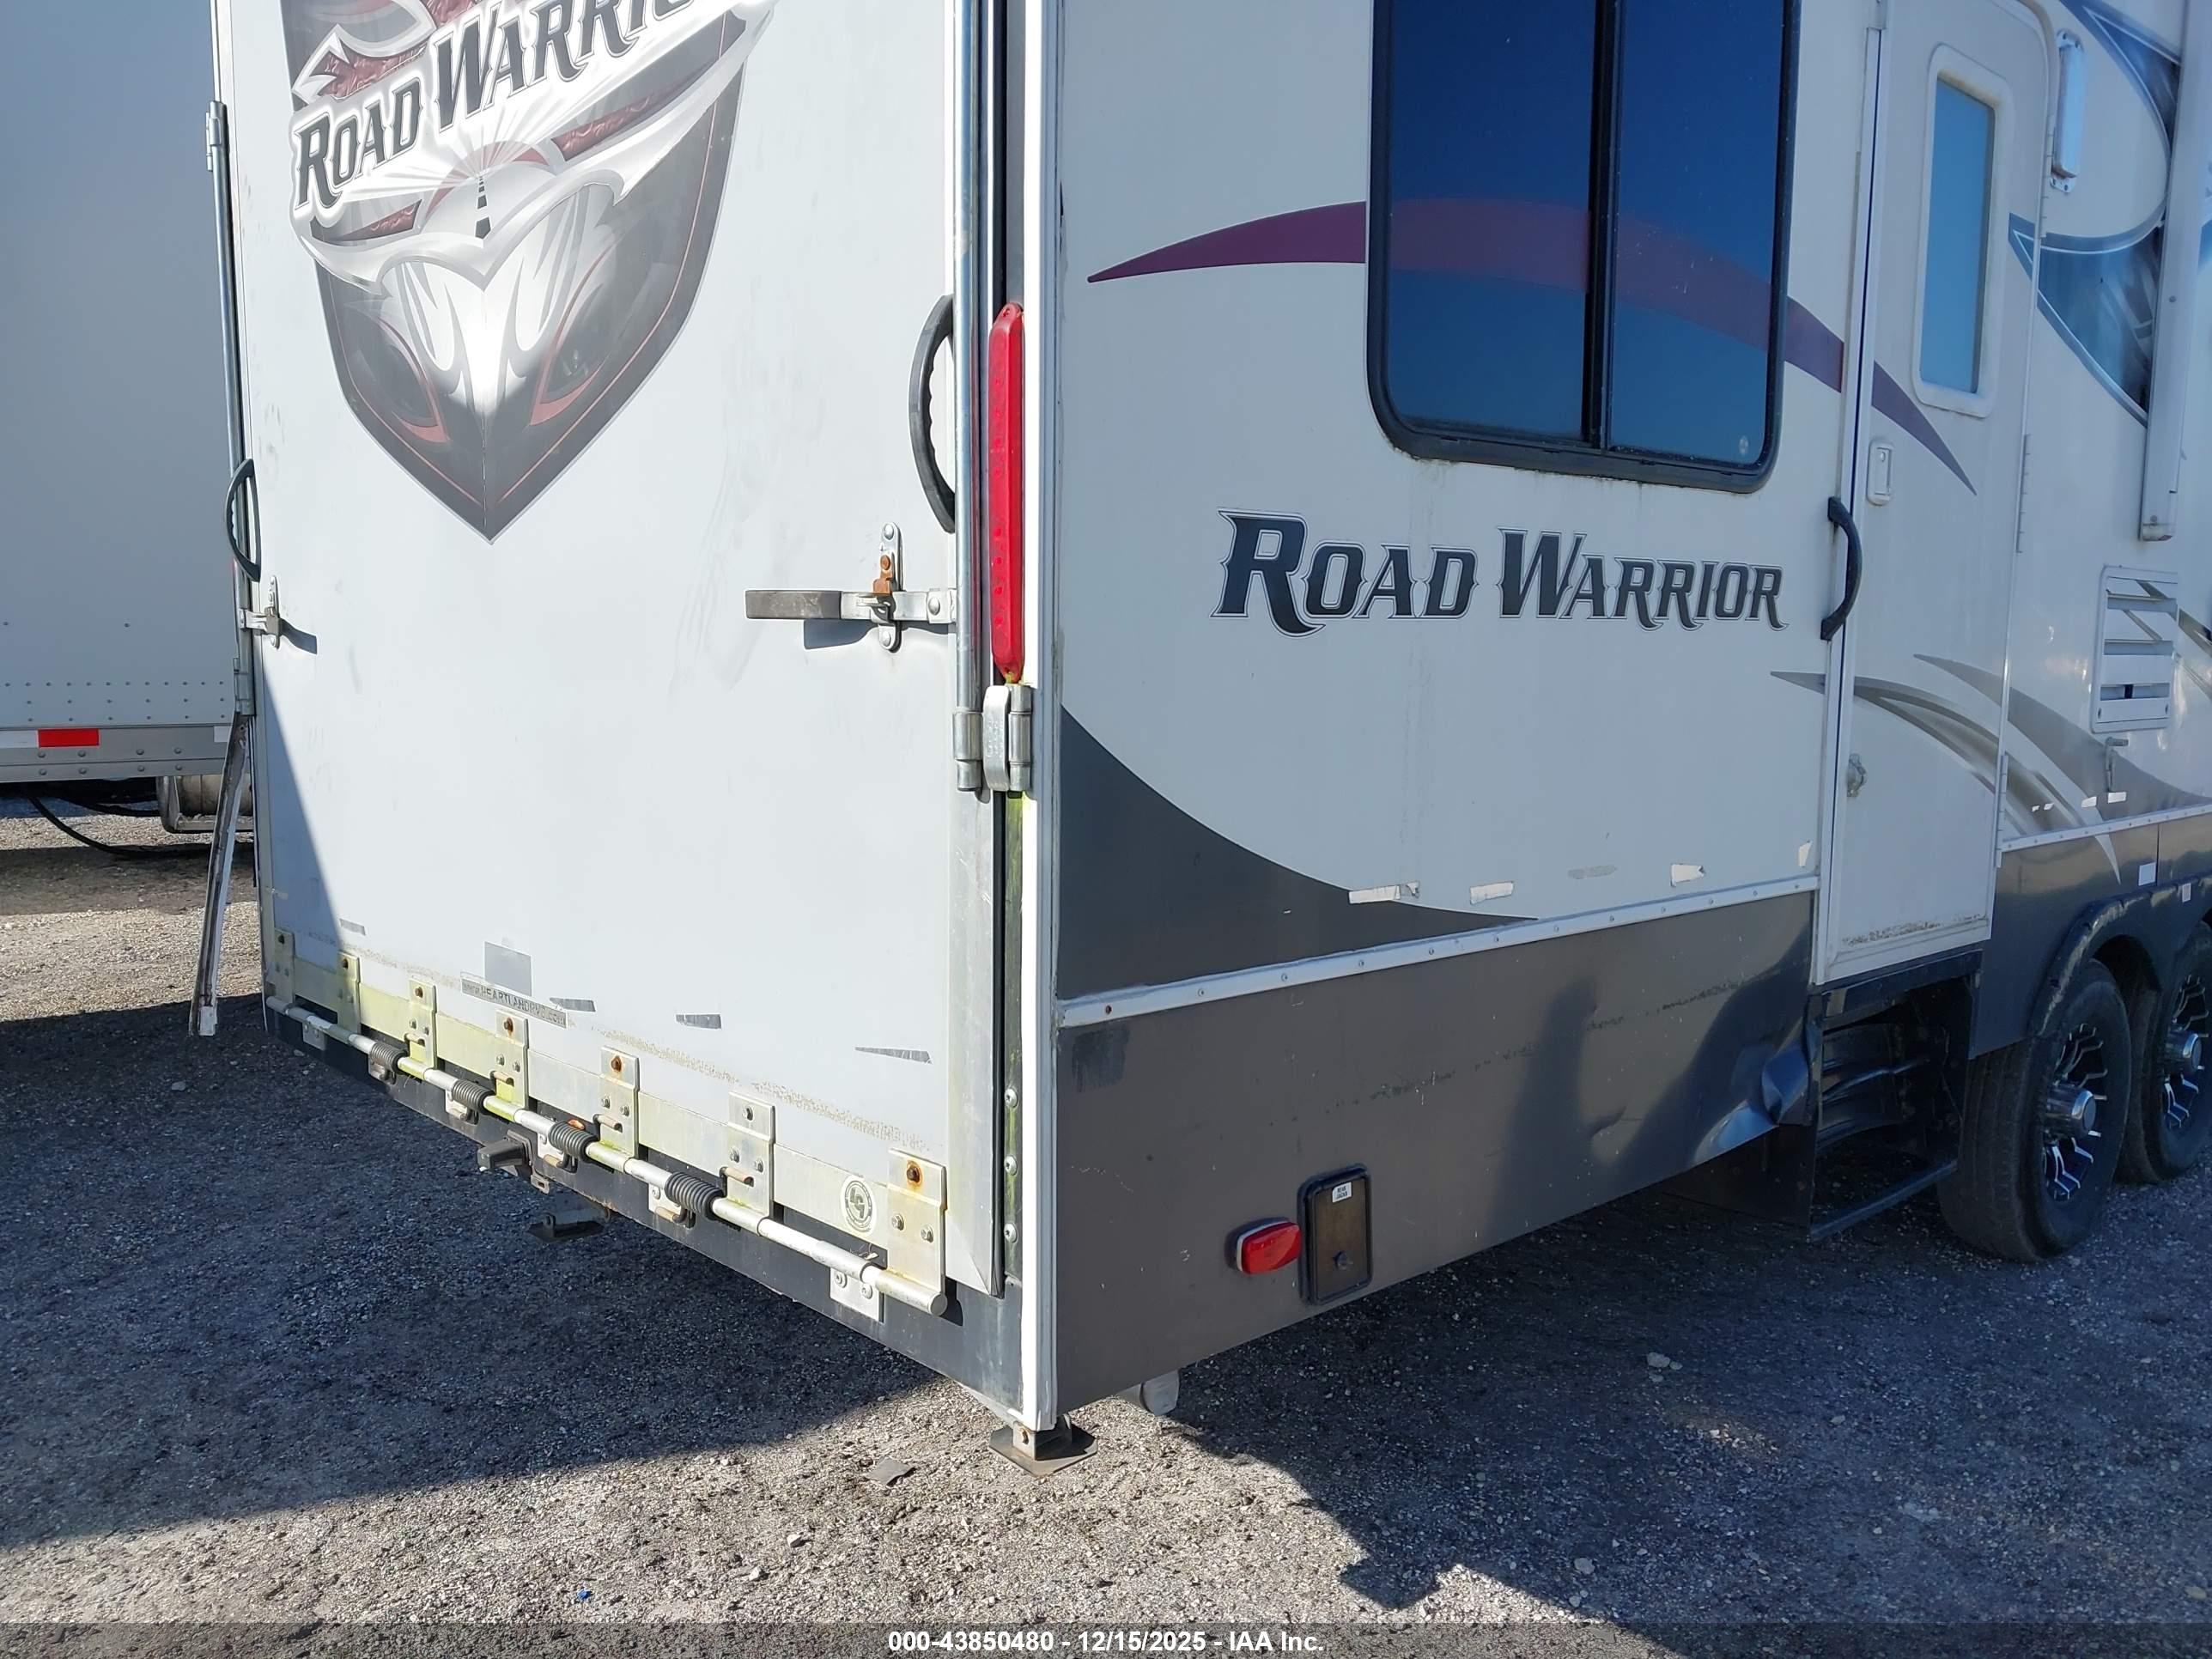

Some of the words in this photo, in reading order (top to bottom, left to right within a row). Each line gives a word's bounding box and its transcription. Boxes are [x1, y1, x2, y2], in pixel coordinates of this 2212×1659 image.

[293, 75, 423, 211] ROAD
[1210, 507, 1479, 637] ROAD
[1497, 526, 1790, 632] WARRIOR
